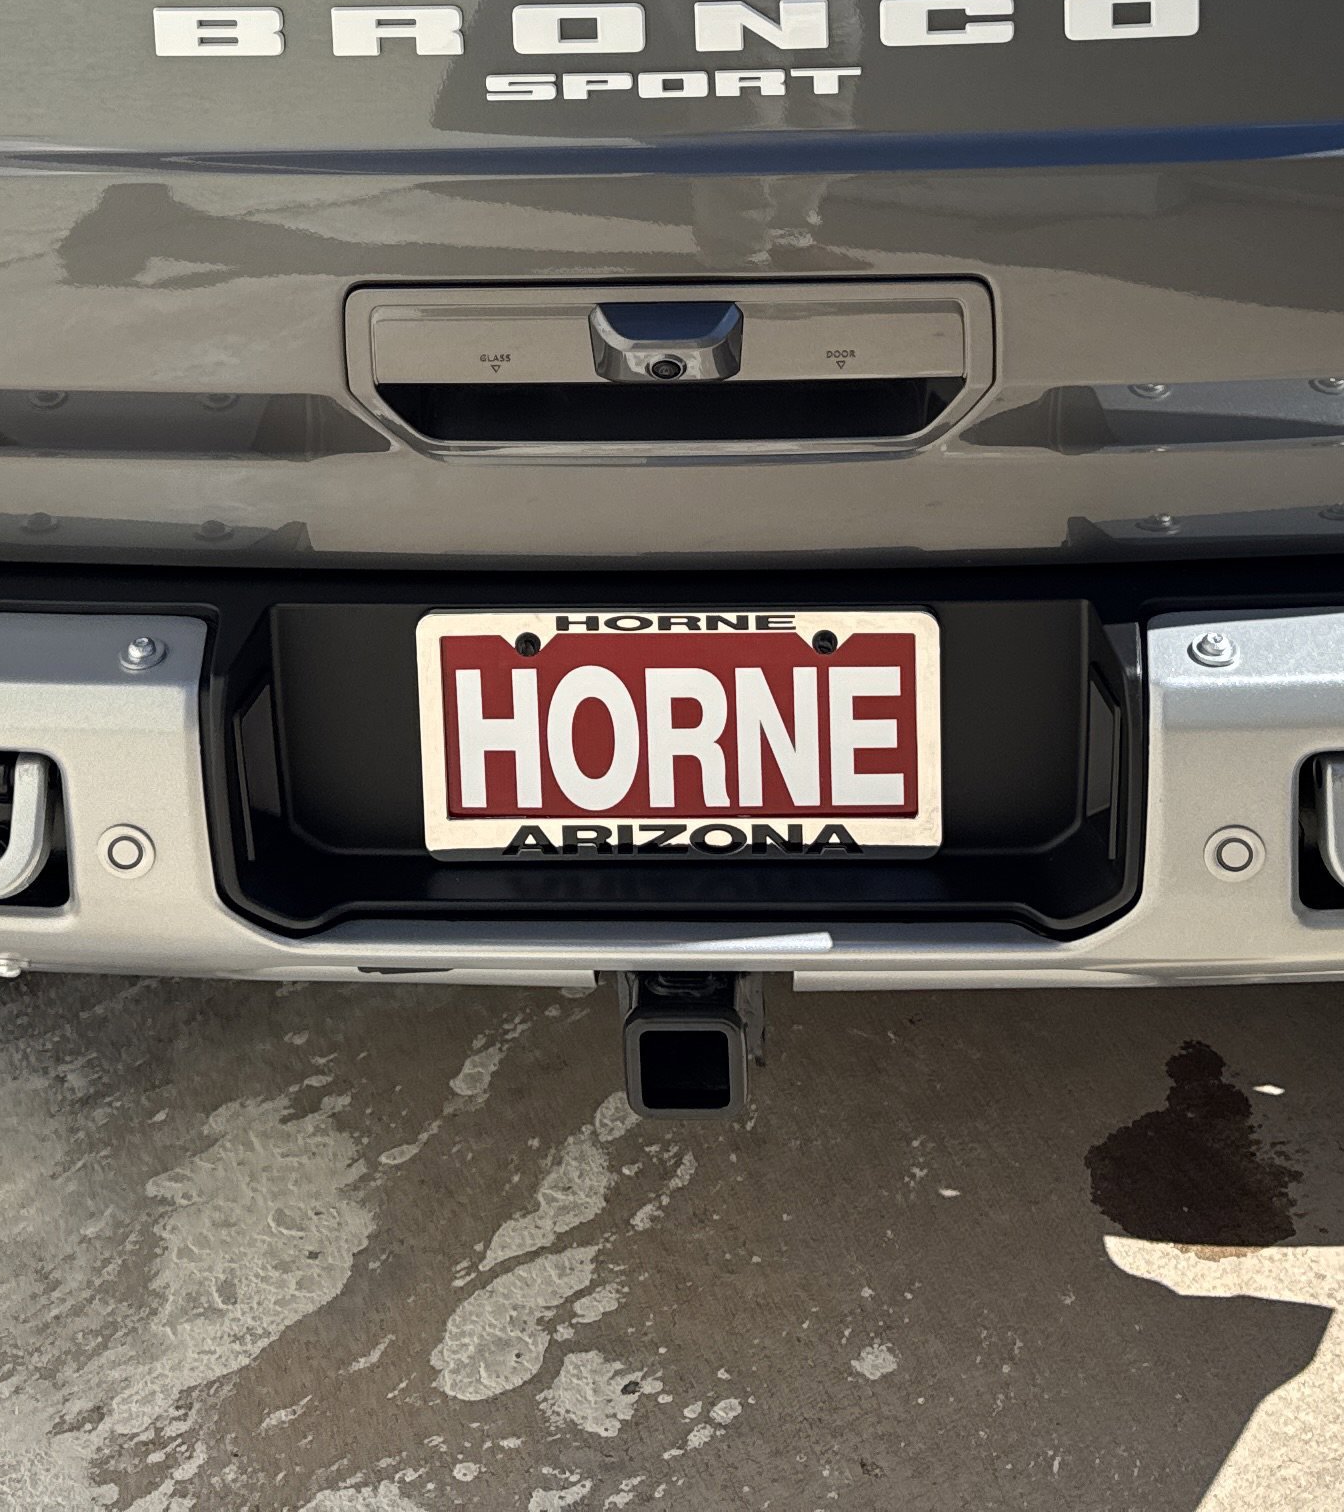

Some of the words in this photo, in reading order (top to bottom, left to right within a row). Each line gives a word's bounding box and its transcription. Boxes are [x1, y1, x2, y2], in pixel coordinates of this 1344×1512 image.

[485, 66, 862, 102] SPORT
[479, 353, 512, 363] GLASS
[826, 349, 857, 359] DOOR
[555, 614, 797, 632] HORNE
[455, 664, 906, 812] HORNE
[501, 823, 864, 856] ARIZONA
